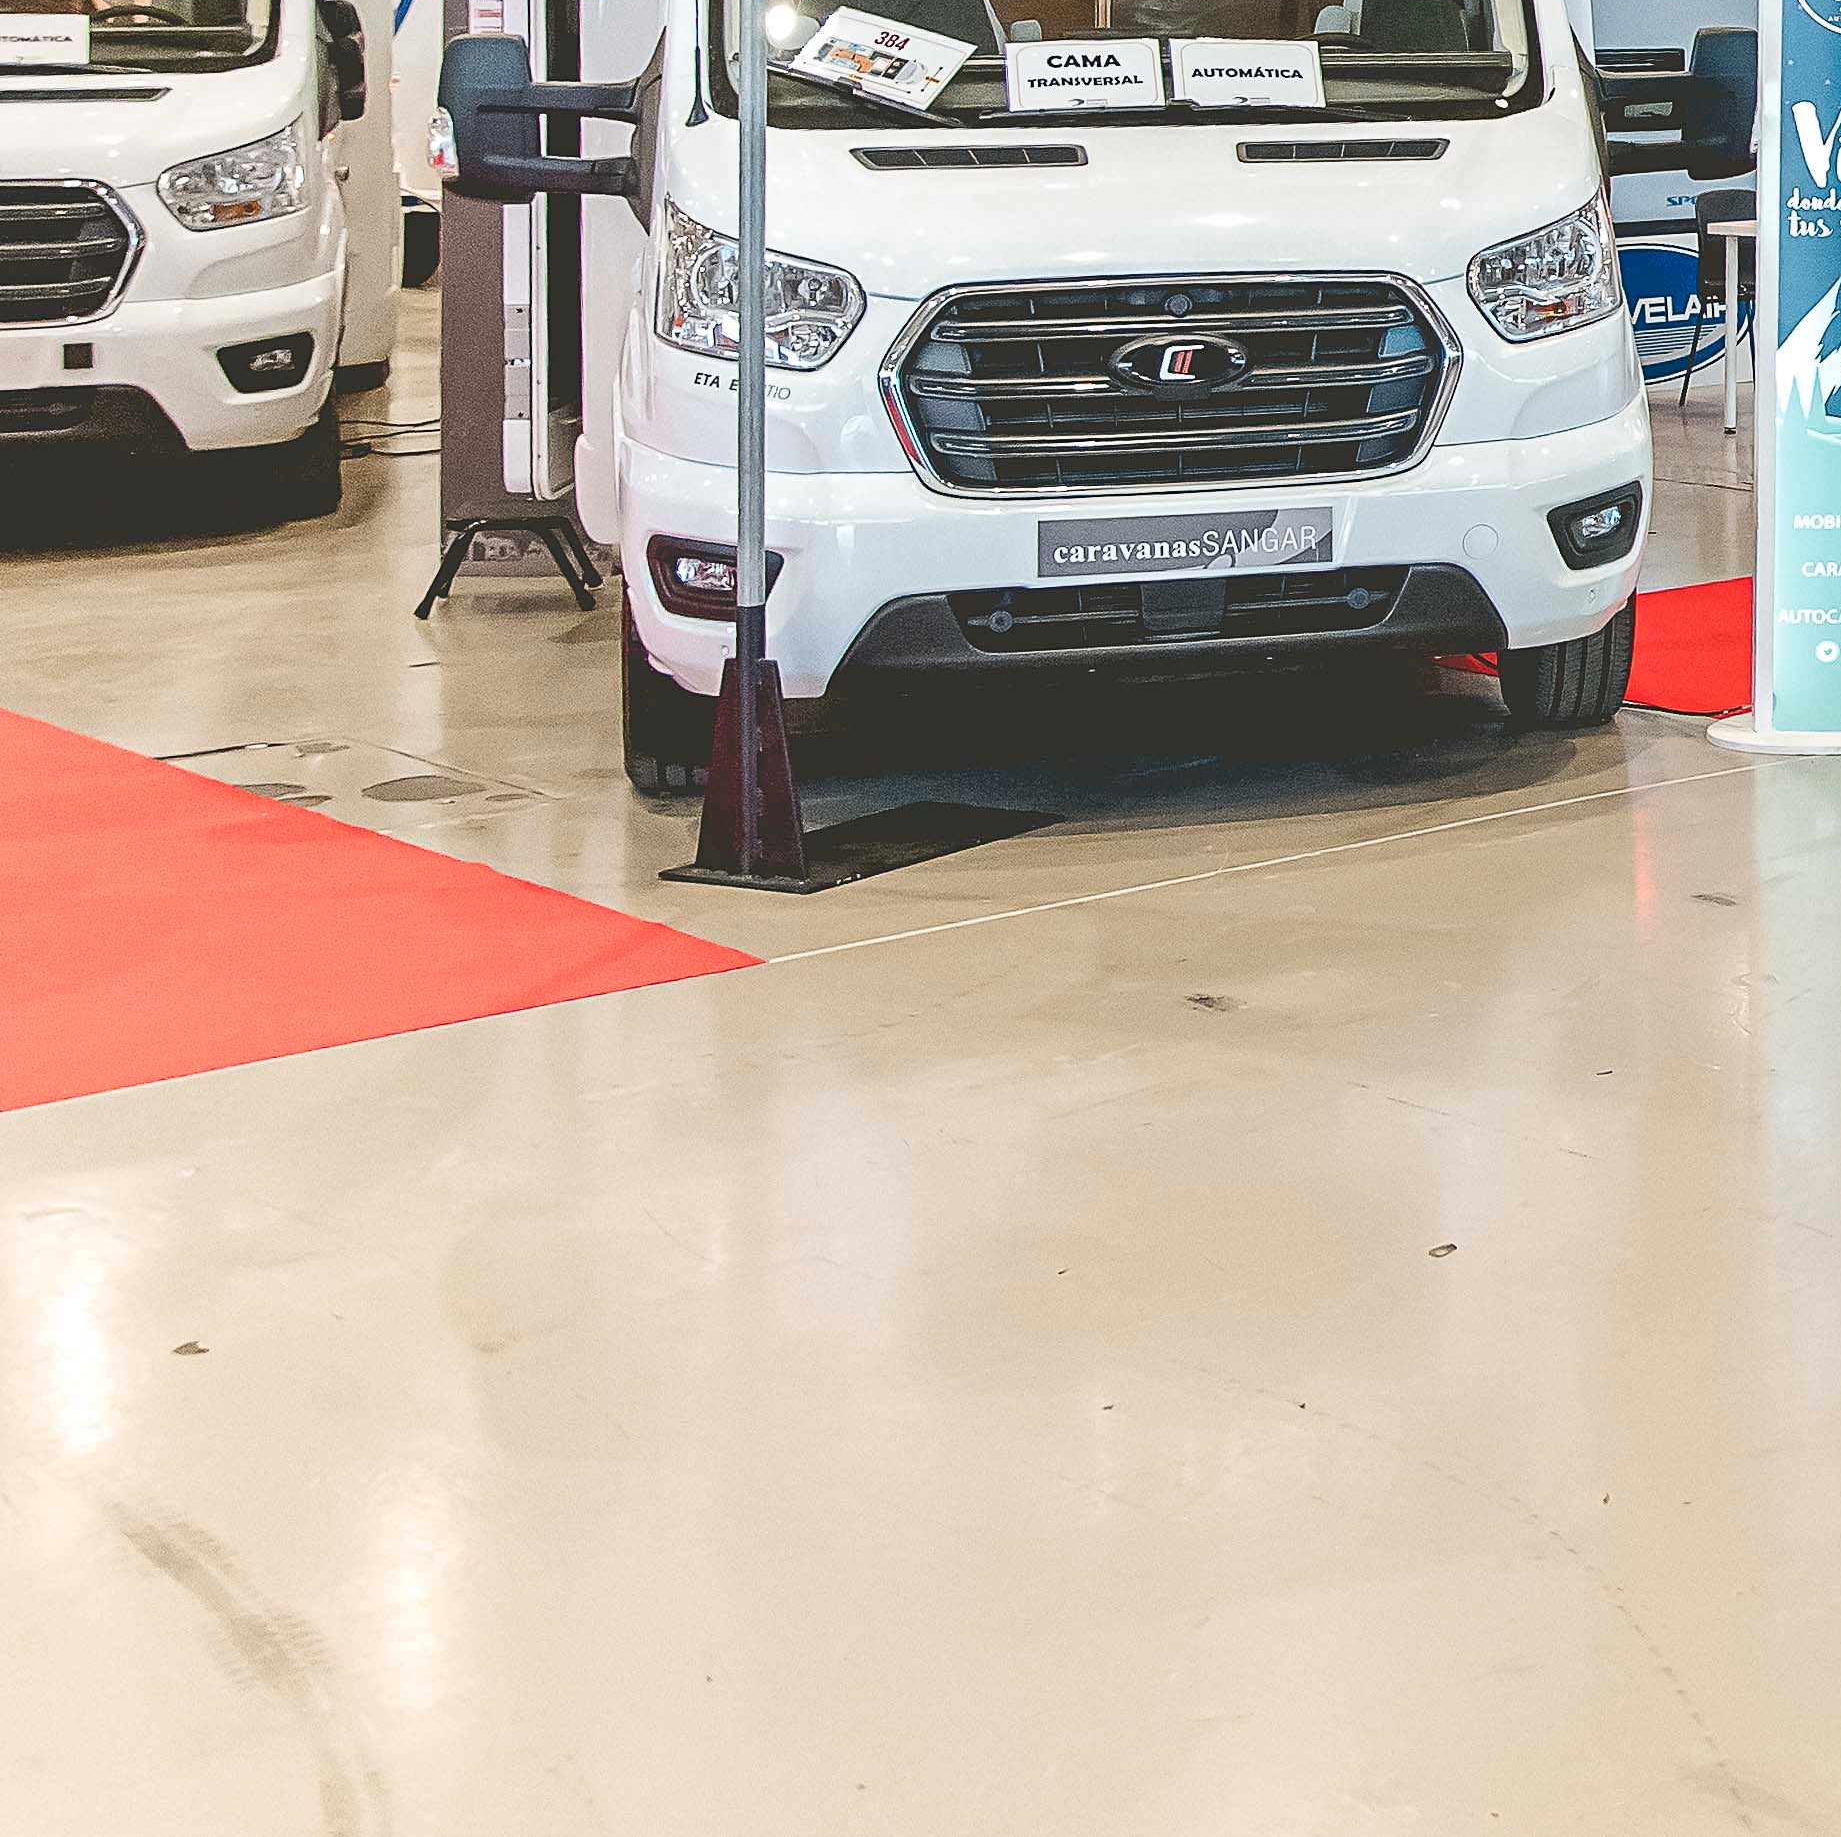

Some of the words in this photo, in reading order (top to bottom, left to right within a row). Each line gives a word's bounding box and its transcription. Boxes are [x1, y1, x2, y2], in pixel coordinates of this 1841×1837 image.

[874, 30, 911, 51] 384
[1046, 54, 1121, 70] CAMA
[1191, 65, 1304, 80] AUTOMÁTICA
[1028, 74, 1143, 89] TRANSVERSAL
[1788, 209, 1834, 238] tus
